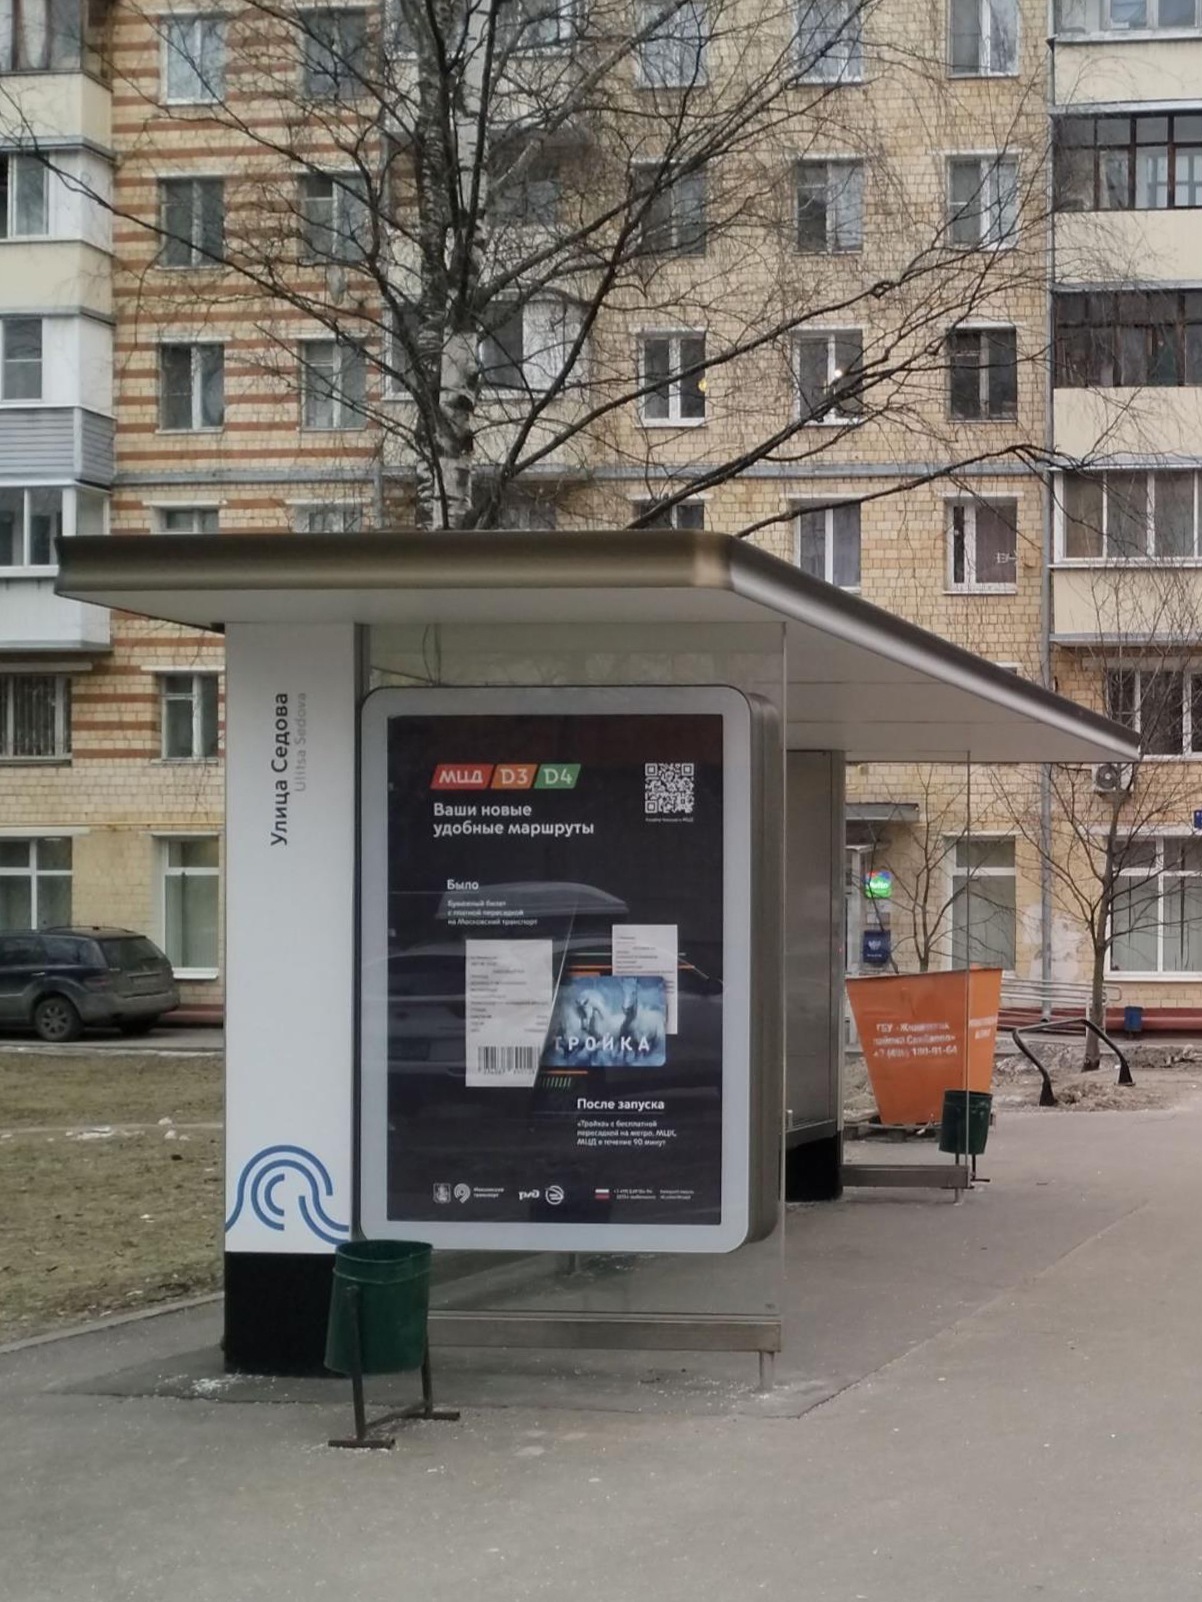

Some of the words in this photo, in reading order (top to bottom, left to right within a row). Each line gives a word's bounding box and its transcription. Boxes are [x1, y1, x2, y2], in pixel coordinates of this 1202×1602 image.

[294, 692, 307, 745] Sedova
[271, 692, 290, 773] Седова
[294, 749, 307, 792] Ulitsa
[438, 768, 484, 784] МЦД
[500, 768, 529, 785] D3
[543, 767, 573, 785] D4
[271, 780, 290, 846] Улица
[433, 802, 477, 817] Ваши
[481, 804, 532, 817] новые
[432, 820, 504, 837] удобные
[507, 822, 594, 838] маршруты
[446, 878, 479, 891] Было
[457, 918, 501, 926] Московский
[502, 918, 539, 927] транспорт
[553, 1032, 651, 1052] ТРОЙКА
[576, 1097, 616, 1110] После
[617, 1100, 665, 1112] запуска
[616, 1119, 658, 1128] бесплатной
[576, 1128, 619, 1138] пересадкой
[576, 1138, 597, 1147] МЦД
[632, 1138, 644, 1146] 90
[644, 1139, 666, 1148] минут
